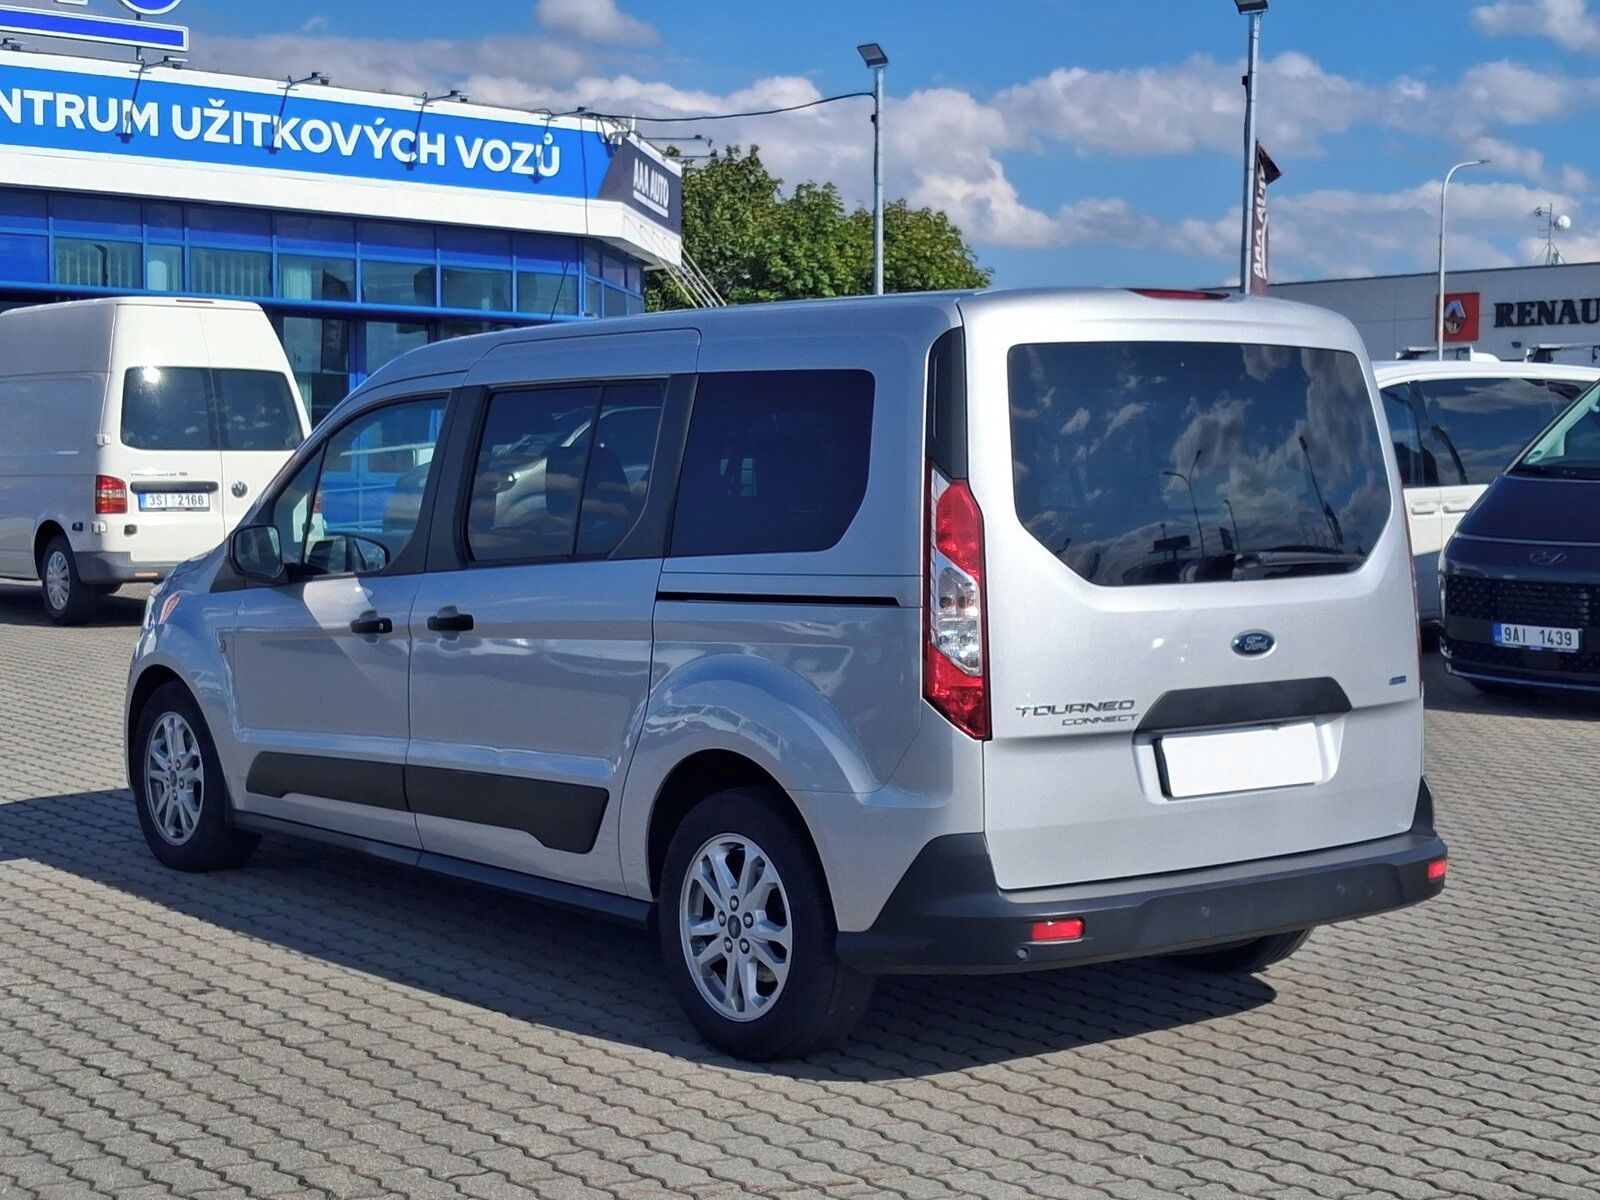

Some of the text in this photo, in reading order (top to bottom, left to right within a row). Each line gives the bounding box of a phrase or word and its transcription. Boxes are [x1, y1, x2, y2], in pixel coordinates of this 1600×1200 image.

[171, 98, 446, 166] UŽITKOVÝCH
[455, 131, 561, 177] VOZŮ
[633, 157, 670, 209] AAA AUTO
[149, 494, 168, 506] 3SI
[1504, 626, 1572, 646] 9AI 1439
[1015, 699, 1136, 717] TOURNEO
[1062, 713, 1139, 726] CONNECT
